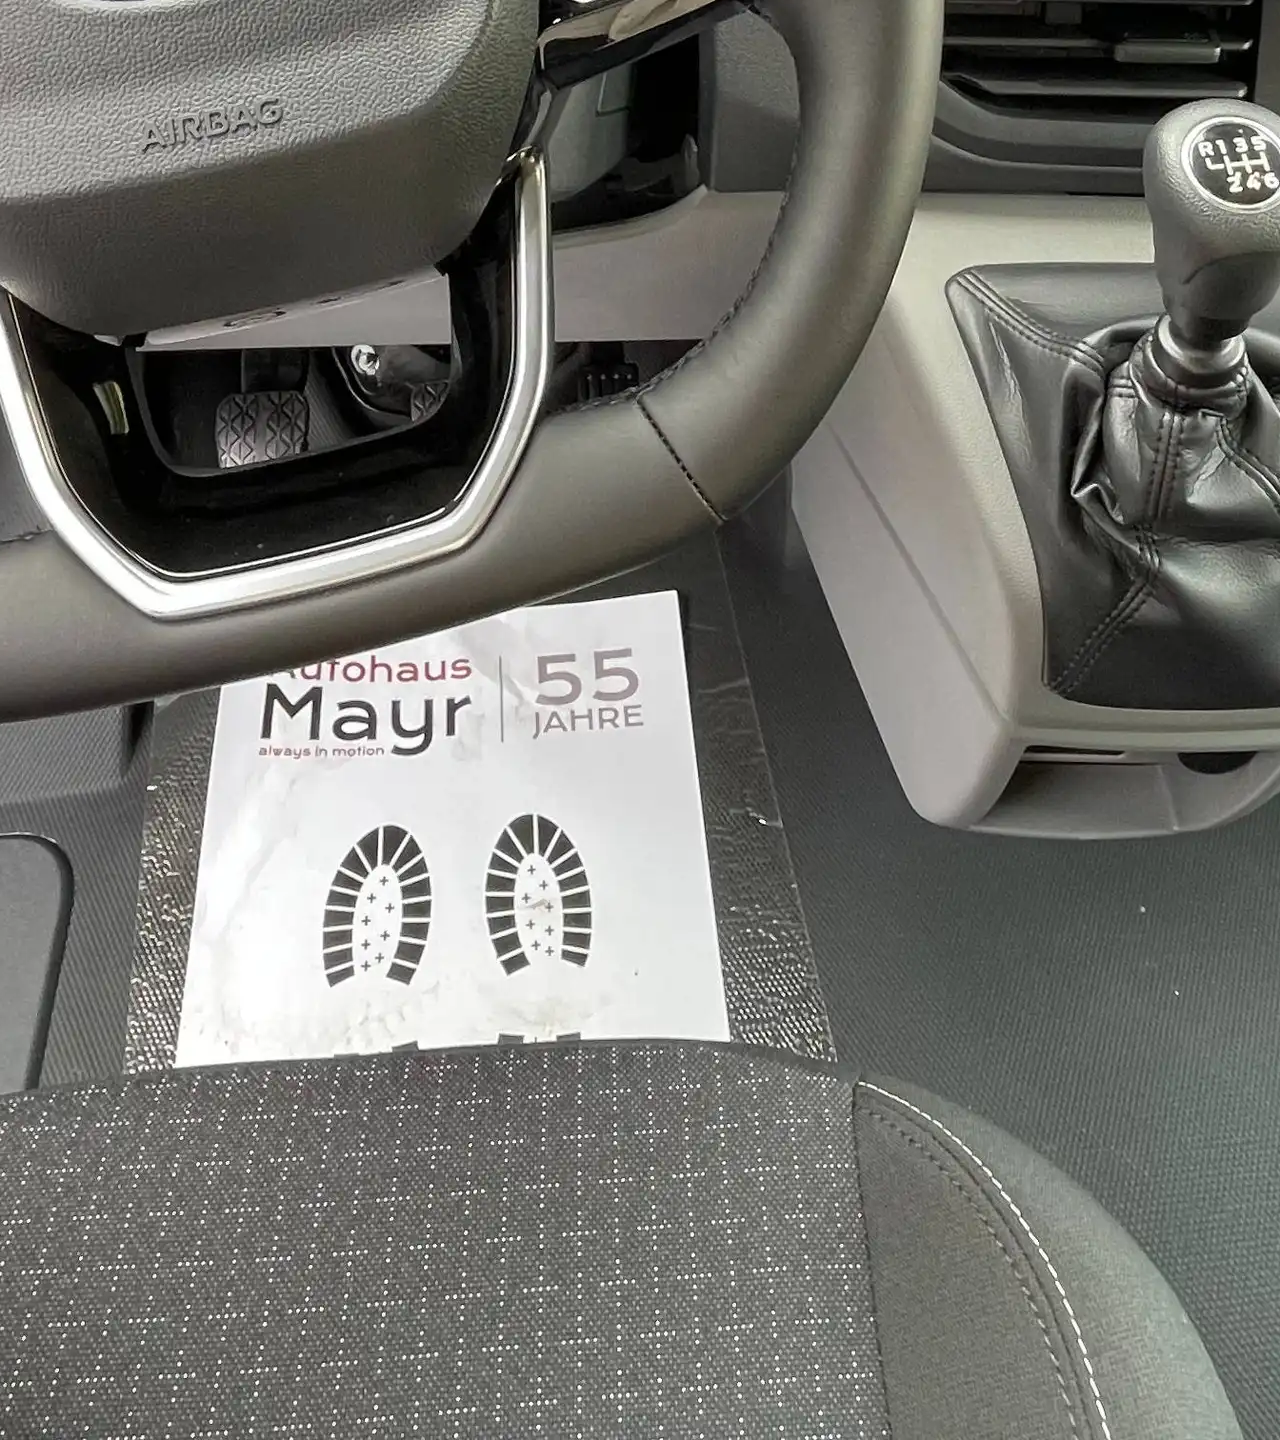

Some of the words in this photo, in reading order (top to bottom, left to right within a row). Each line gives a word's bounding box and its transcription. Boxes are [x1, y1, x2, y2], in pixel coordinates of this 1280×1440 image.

[140, 98, 284, 153] AIRBAG
[535, 647, 640, 706] 55
[260, 682, 473, 757] Mayr
[532, 704, 645, 740] JAHRE
[258, 745, 312, 760] always
[314, 744, 329, 757] in
[332, 744, 385, 758] motion
